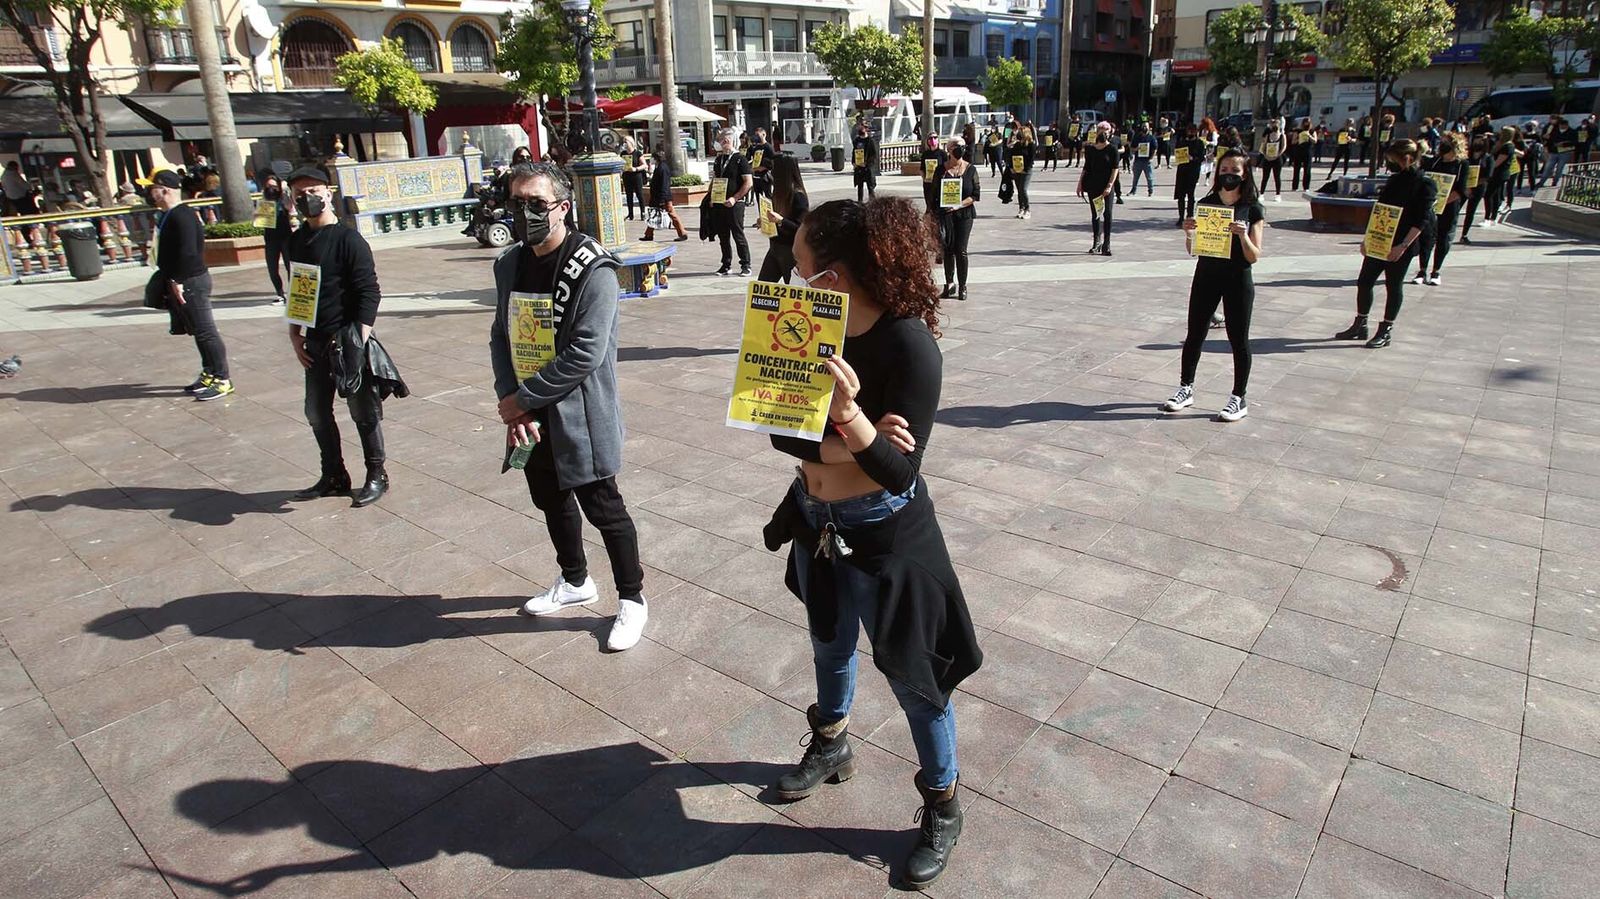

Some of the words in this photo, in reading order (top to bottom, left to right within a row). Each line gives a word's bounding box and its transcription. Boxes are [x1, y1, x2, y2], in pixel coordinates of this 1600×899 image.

[753, 284, 770, 297] DIA
[774, 286, 787, 298] 22
[789, 288, 803, 300] DE
[805, 290, 842, 306] MARZO
[752, 297, 779, 308] ALGECIRAS
[812, 305, 828, 314] PLAZA
[828, 308, 841, 316] ALTA
[819, 344, 827, 354] 10
[760, 366, 812, 384] NACIONAL
[752, 388, 773, 401] IVA
[776, 393, 785, 402] al
[787, 394, 810, 406] 10%
